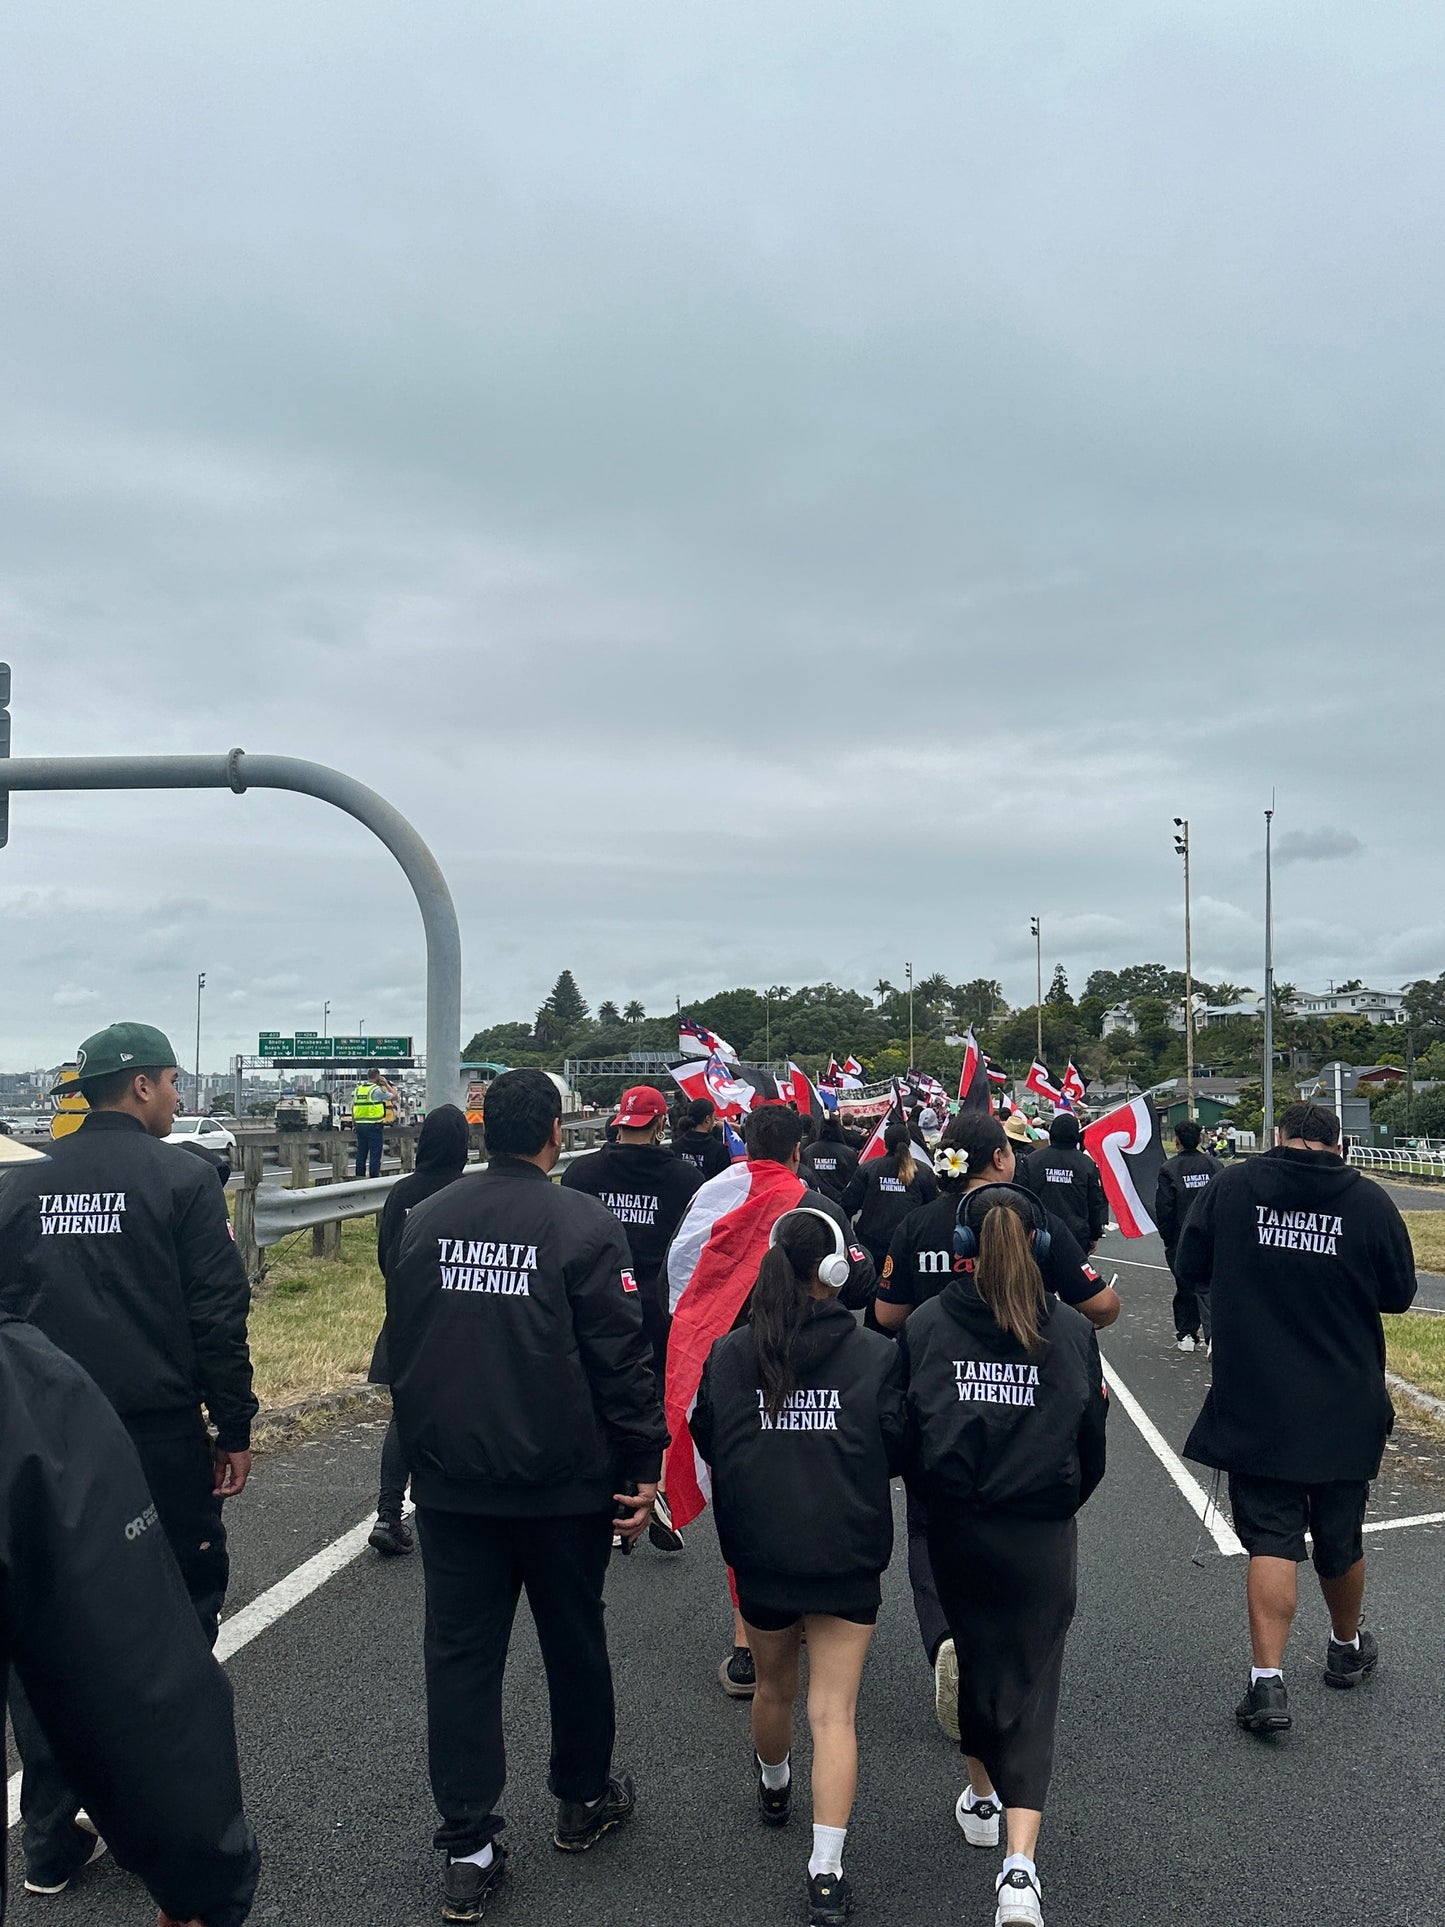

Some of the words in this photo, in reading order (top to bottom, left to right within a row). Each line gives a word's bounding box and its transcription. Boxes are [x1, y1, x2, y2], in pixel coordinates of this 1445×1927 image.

[879, 1176, 903, 1185] TANGA
[1045, 1168, 1074, 1177] TANGATA
[39, 1193, 126, 1213] TANGATA
[40, 1214, 122, 1234] WHENUA
[610, 1208, 655, 1224] HENUA
[1256, 1206, 1343, 1236] TANGATA
[1258, 1226, 1337, 1255] WHENUA
[438, 1239, 538, 1270] TANGATA
[440, 1266, 530, 1296] WHENUA
[952, 1361, 1040, 1385] TANGATA
[756, 1389, 841, 1409] TNGATA
[956, 1382, 1036, 1406] WHENUA
[759, 1410, 838, 1430] WHENUA
